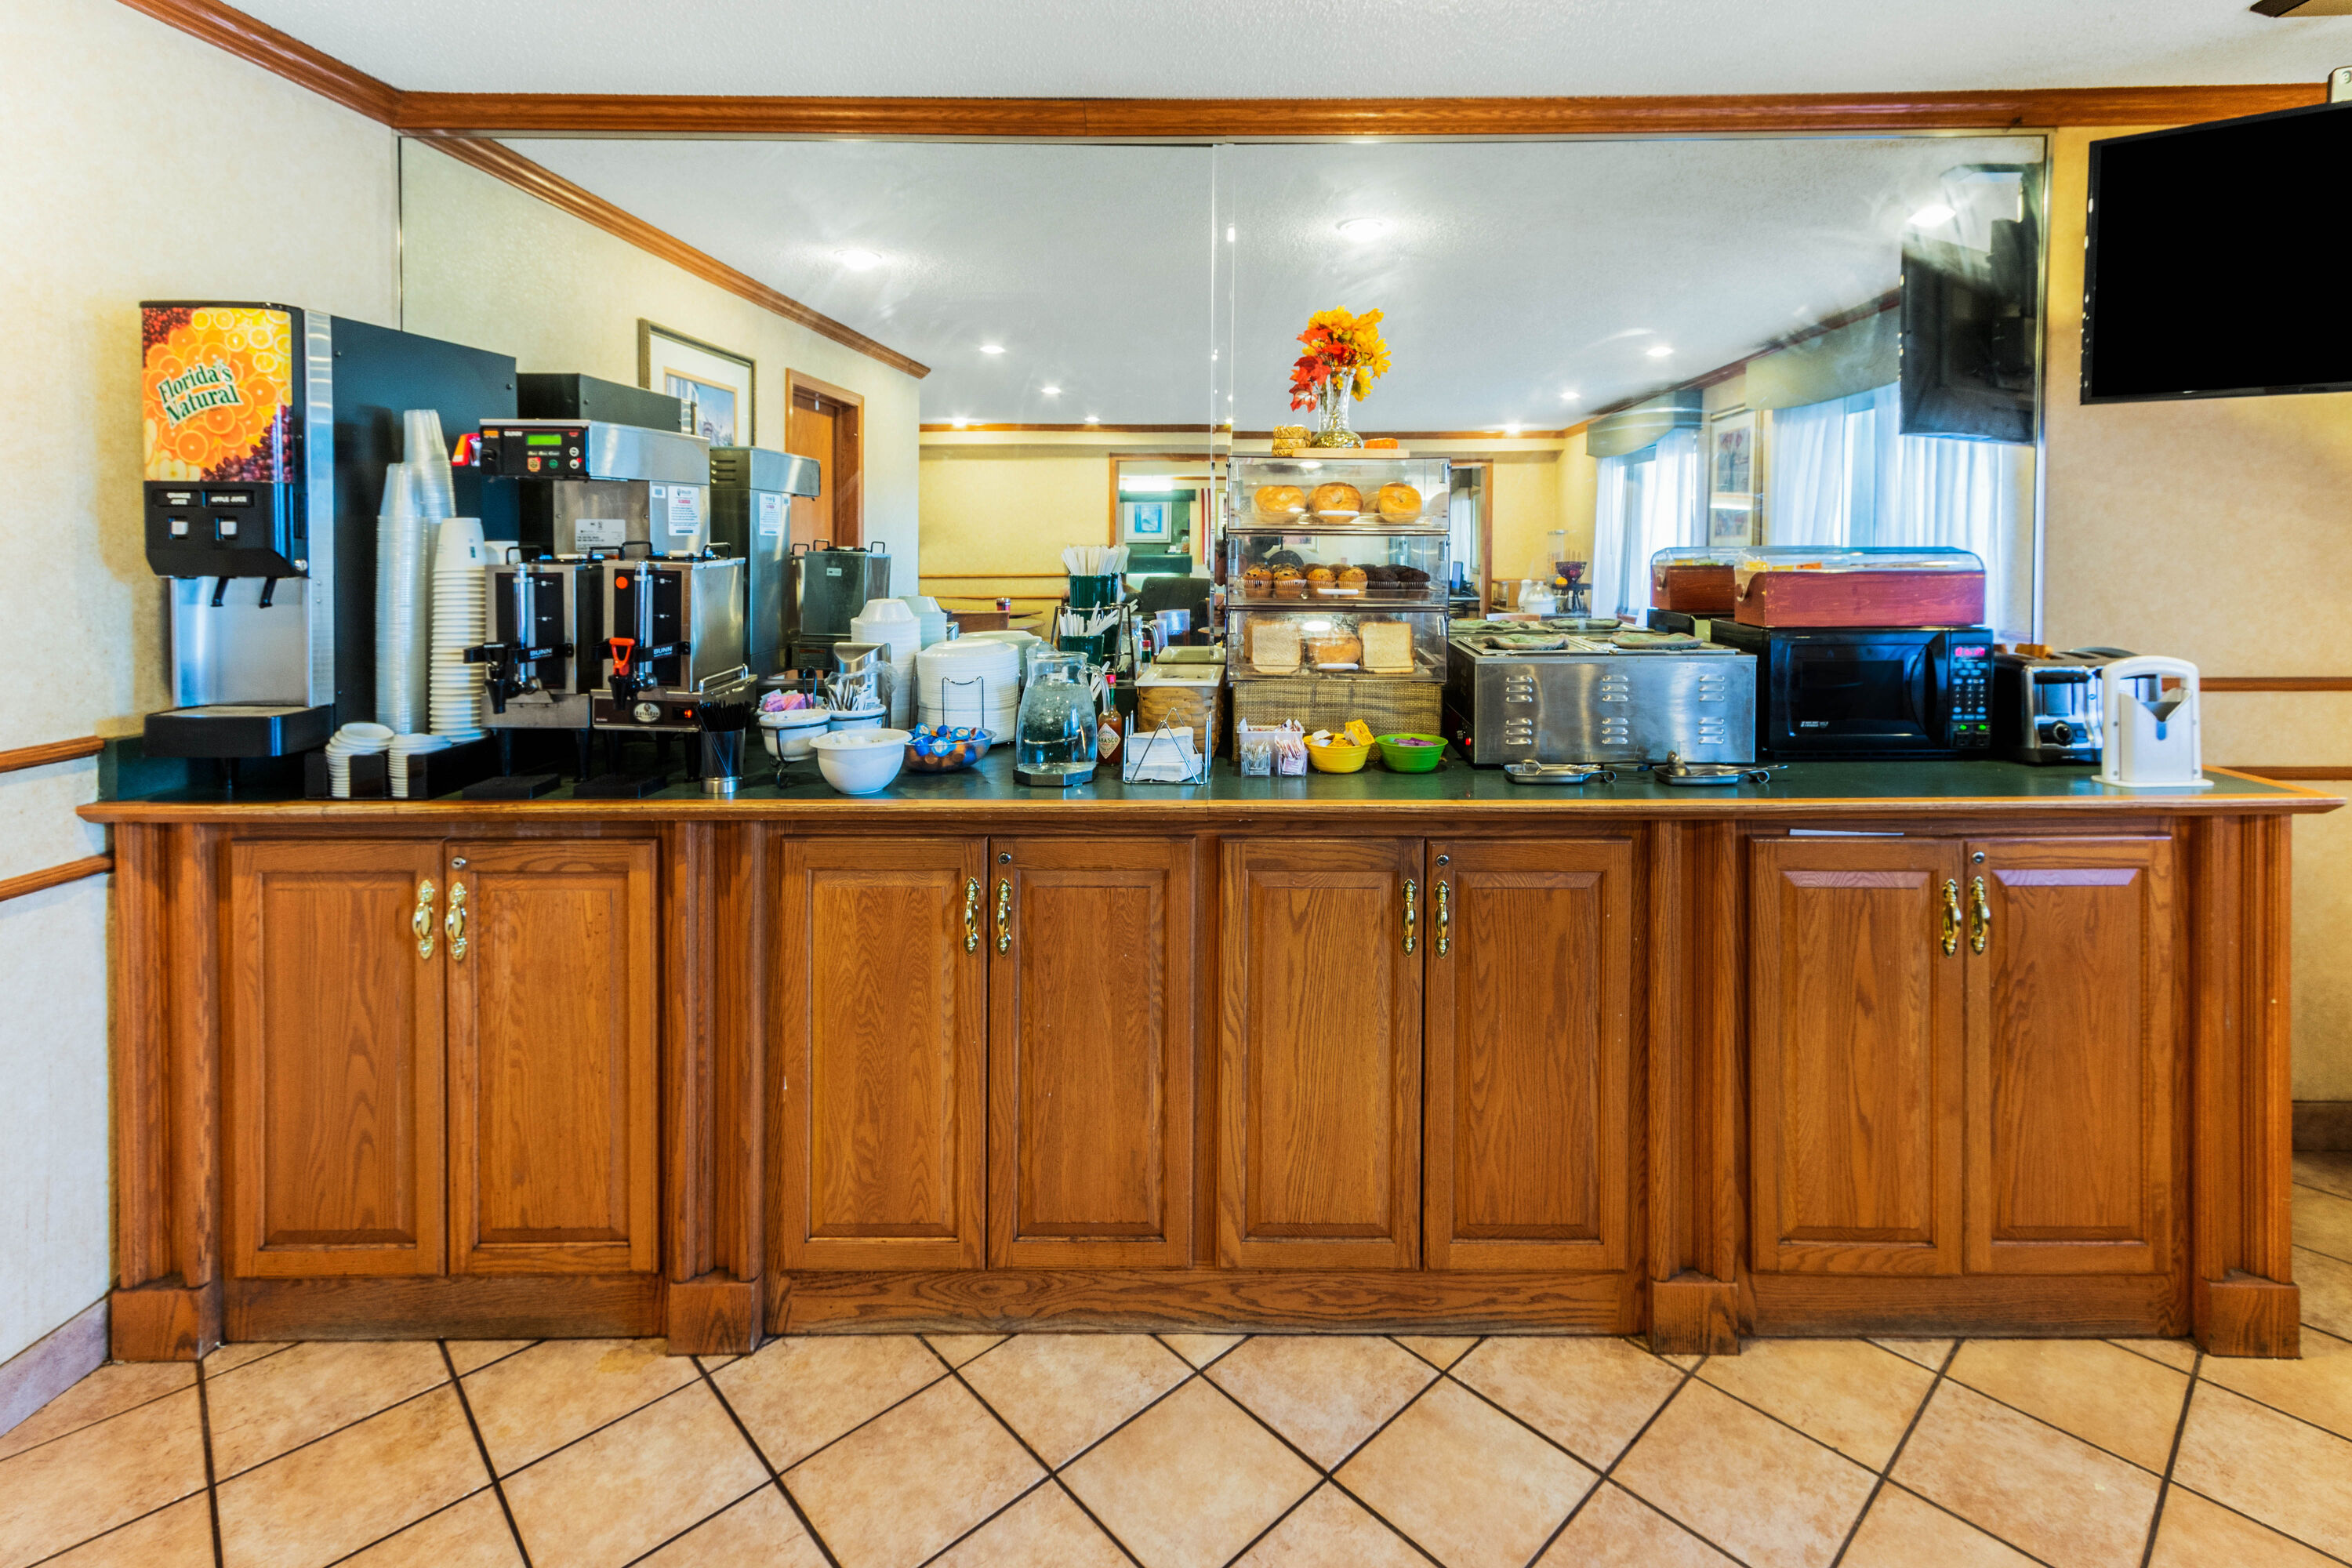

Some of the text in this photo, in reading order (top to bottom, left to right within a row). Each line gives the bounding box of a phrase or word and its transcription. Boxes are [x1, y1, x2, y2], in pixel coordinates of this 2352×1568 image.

[158, 364, 234, 404] Florida's
[165, 384, 241, 426] Natural
[529, 648, 553, 657] BUNN
[653, 645, 673, 655] BUNN
